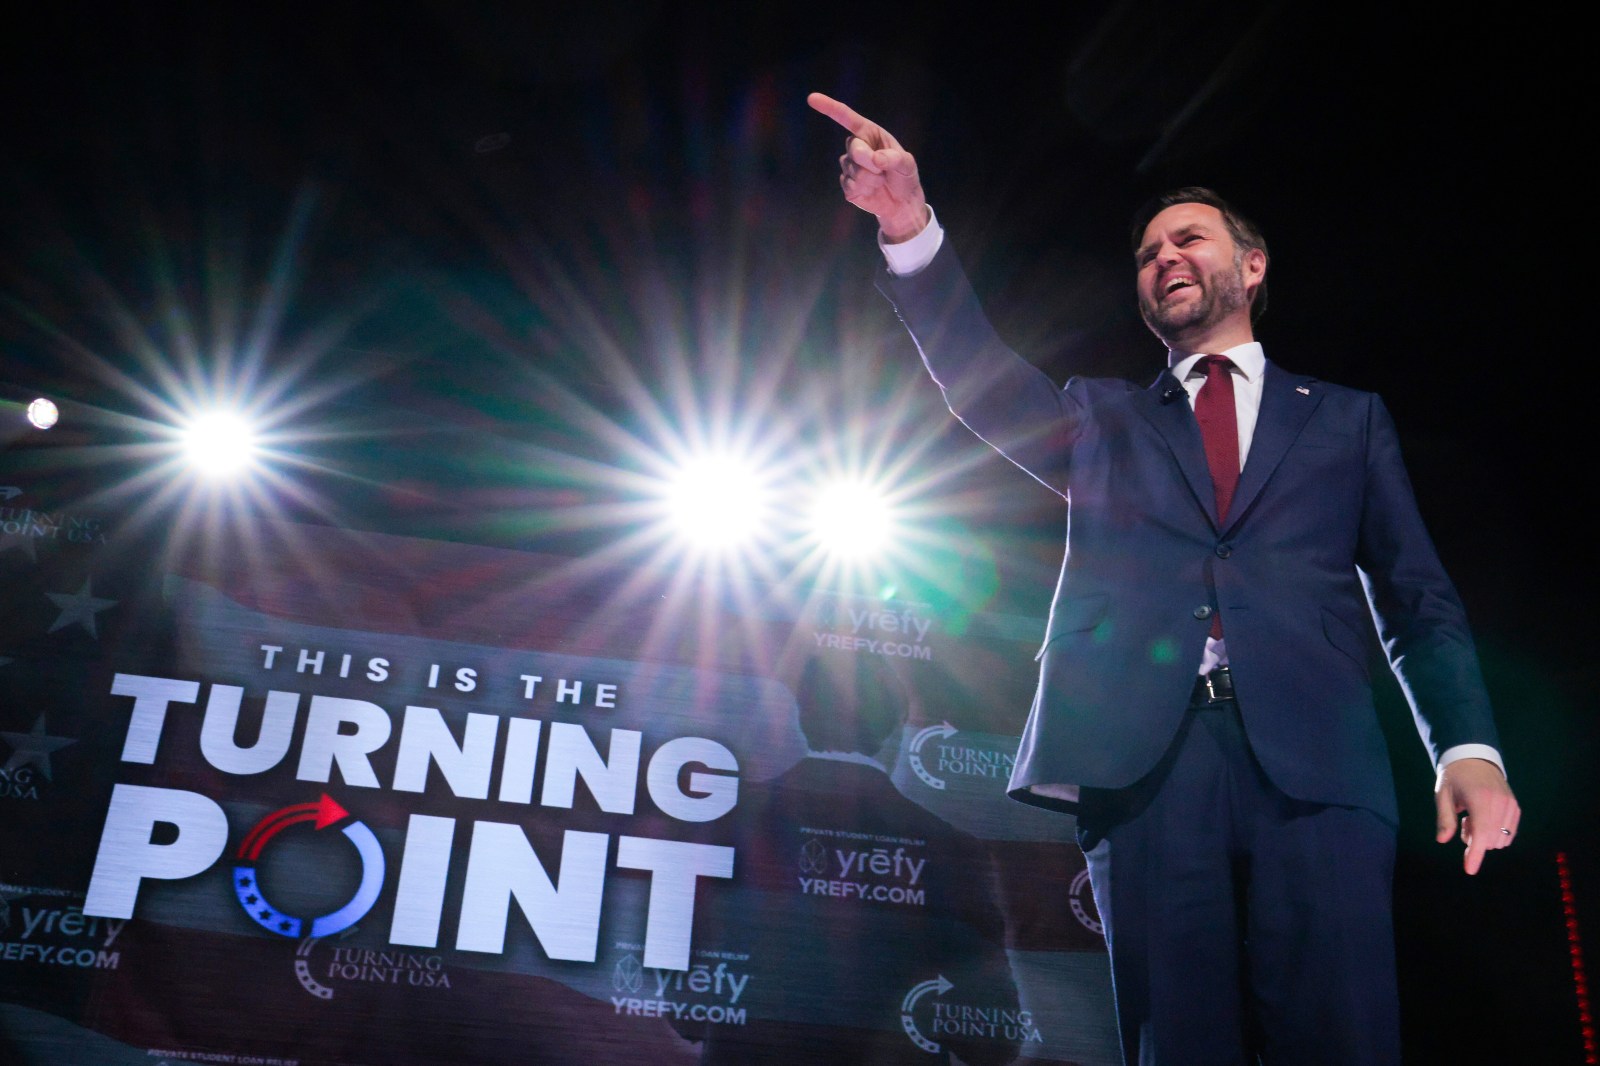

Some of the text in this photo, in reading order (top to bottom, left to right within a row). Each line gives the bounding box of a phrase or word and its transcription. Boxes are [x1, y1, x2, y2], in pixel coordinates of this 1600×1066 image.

[813, 632, 932, 660] YREFY.COM
[260, 644, 618, 709] THIS IS THE
[110, 672, 740, 823] TURNING
[937, 745, 1016, 764] TURNIN
[938, 758, 999, 778] POINT
[82, 783, 735, 972] POINT
[799, 877, 925, 905] YREFY.COM
[332, 948, 442, 971] TURNING
[328, 963, 452, 988] POINT USA
[611, 996, 747, 1025] YREFY.COM
[932, 1002, 1032, 1026] TURNING
[932, 1018, 1043, 1043] POINT USA
